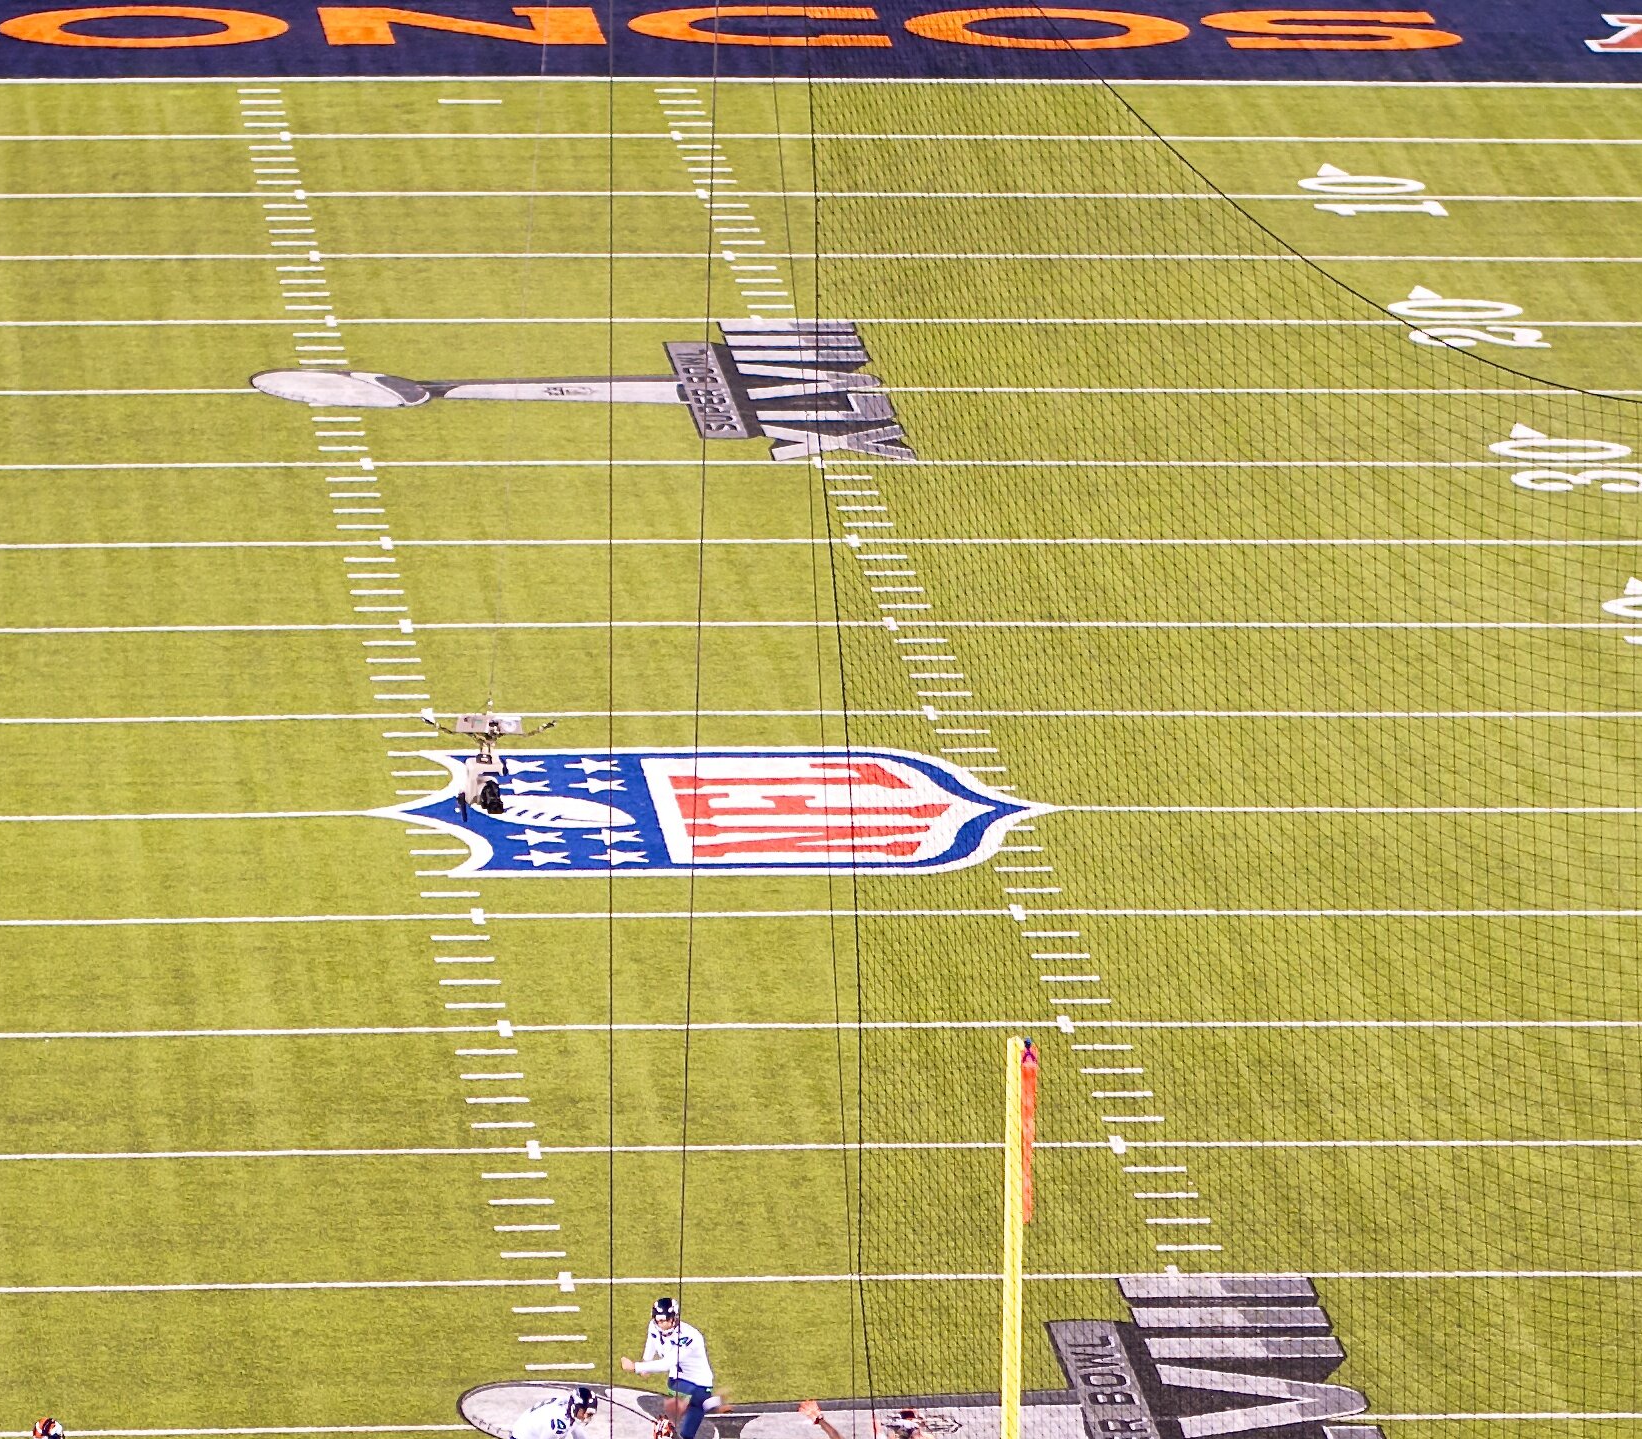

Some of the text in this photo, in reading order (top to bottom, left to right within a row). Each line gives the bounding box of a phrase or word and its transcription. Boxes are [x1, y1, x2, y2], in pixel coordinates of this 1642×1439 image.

[1297, 175, 1450, 216] 10
[1387, 298, 1552, 349] 20
[718, 321, 917, 461] XLVIII
[668, 763, 953, 858] NFL
[1066, 1334, 1141, 1406] BOWL
